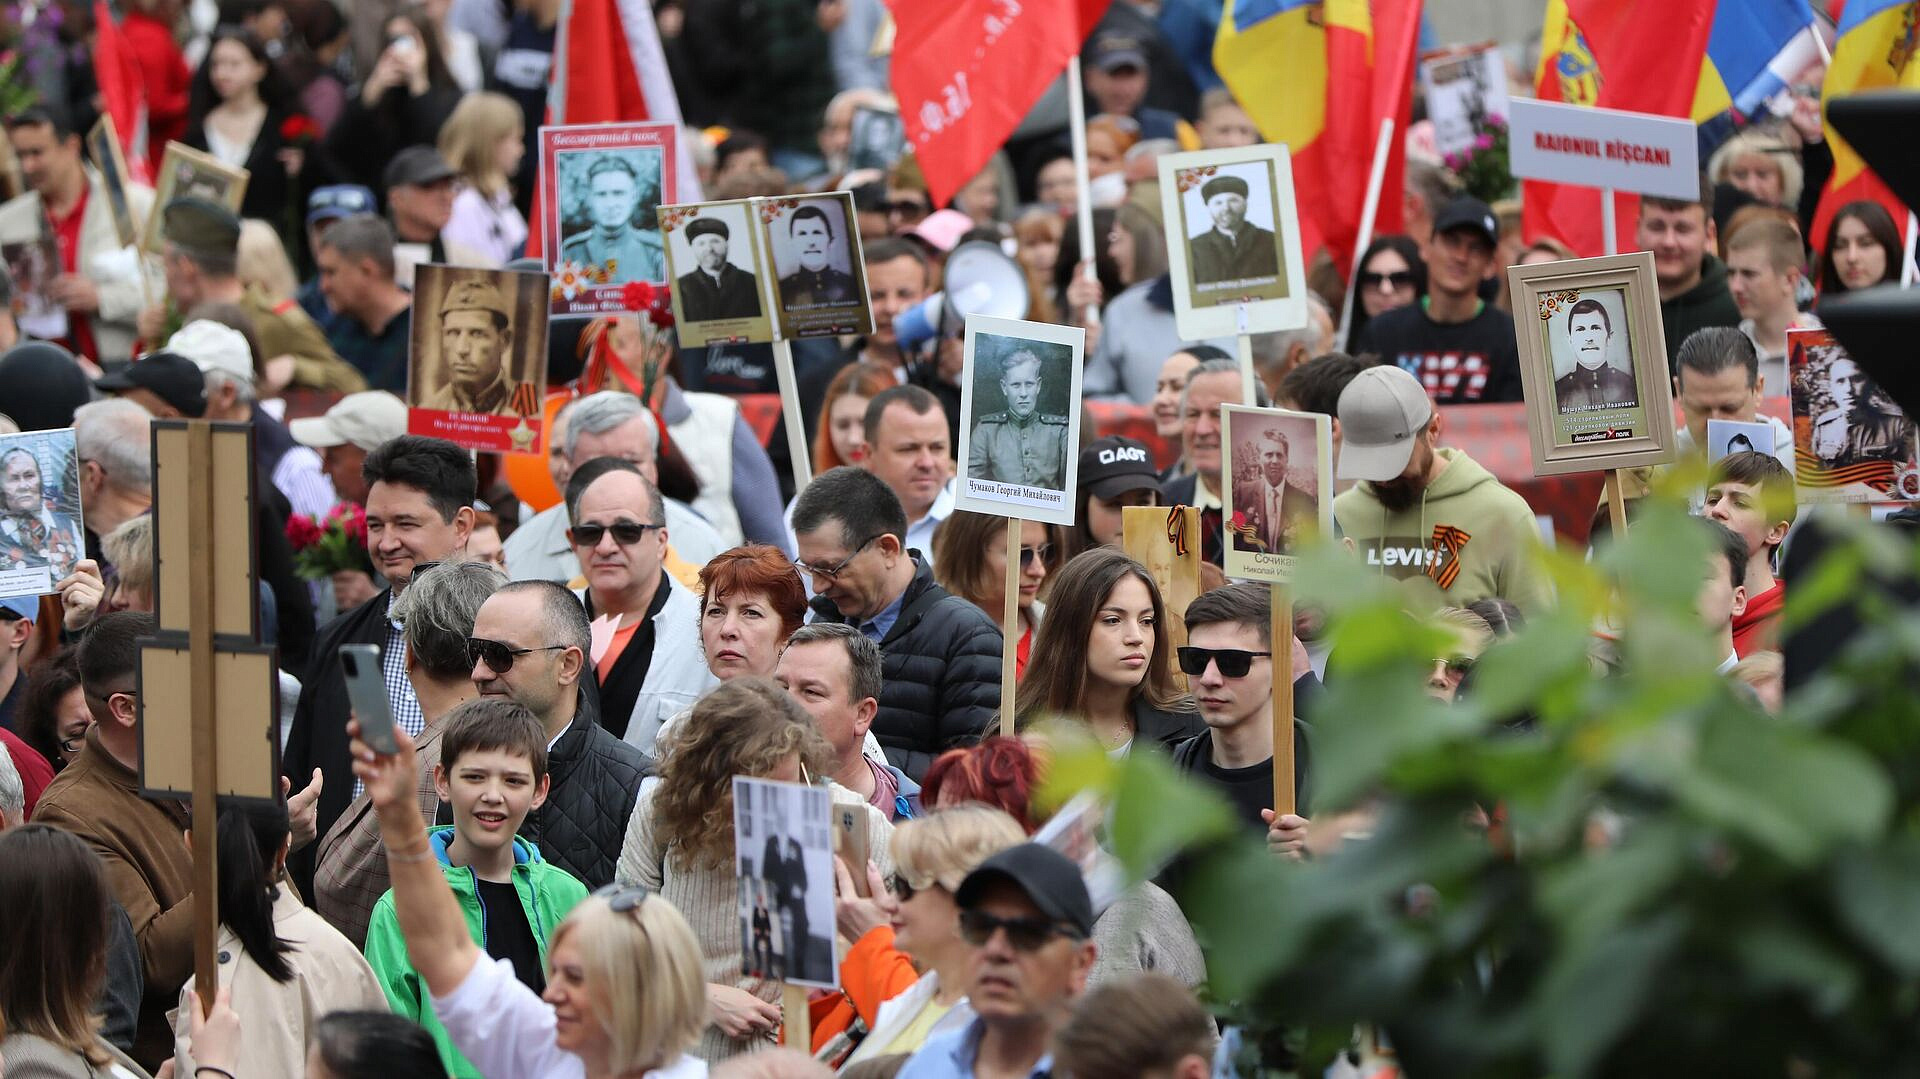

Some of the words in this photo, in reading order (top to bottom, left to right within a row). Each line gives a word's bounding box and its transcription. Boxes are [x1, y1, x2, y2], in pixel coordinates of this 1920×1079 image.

[1534, 131, 1601, 157] RAIONUL
[969, 480, 995, 493] Чумаков
[996, 483, 1021, 498] Георгий
[1022, 488, 1061, 503] Михайлович
[1243, 565, 1275, 576] Николай
